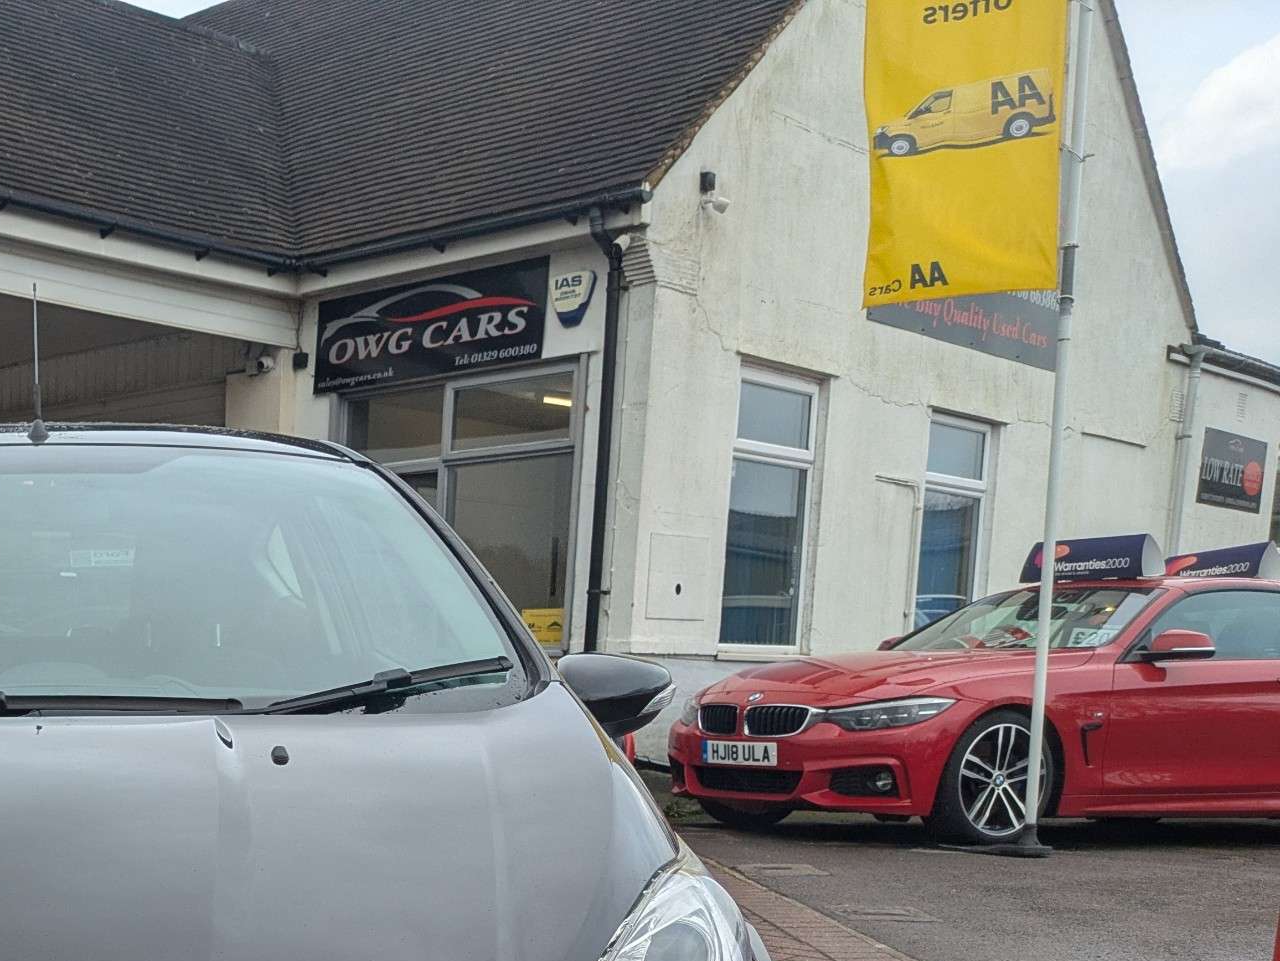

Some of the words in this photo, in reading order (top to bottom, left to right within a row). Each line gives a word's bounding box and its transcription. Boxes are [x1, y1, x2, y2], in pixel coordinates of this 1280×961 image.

[555, 275, 582, 290] IAS
[329, 327, 413, 365] OWG
[422, 306, 528, 349] CARS
[943, 299, 990, 341] Quality
[992, 312, 1020, 339] Used
[1022, 324, 1048, 348] Cars
[742, 744, 770, 762] ULA
